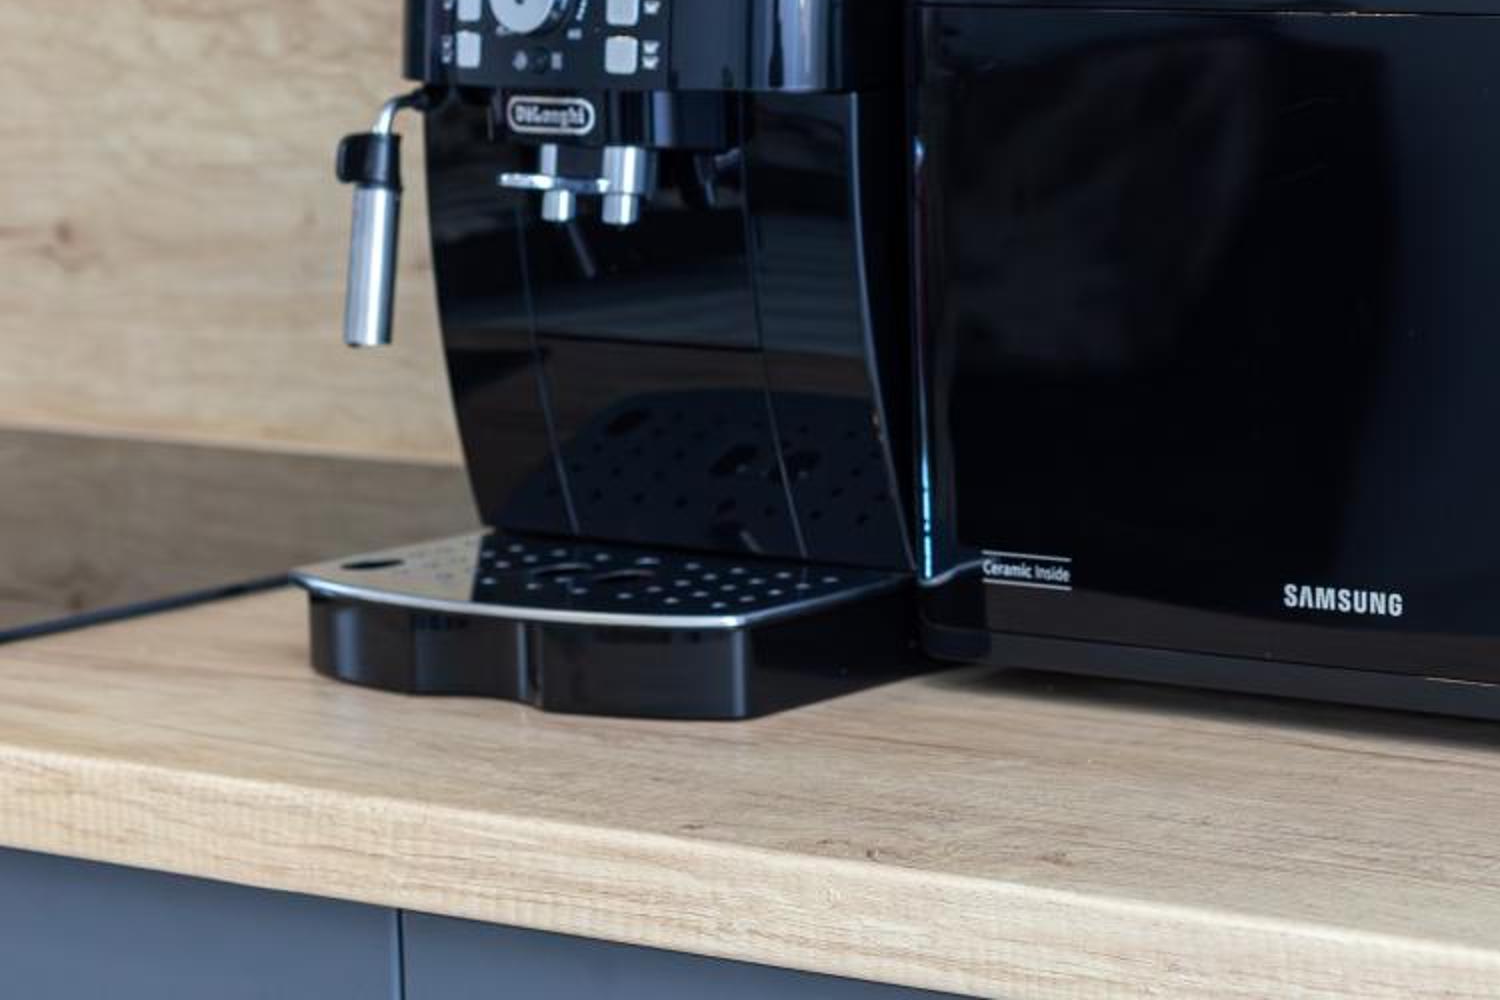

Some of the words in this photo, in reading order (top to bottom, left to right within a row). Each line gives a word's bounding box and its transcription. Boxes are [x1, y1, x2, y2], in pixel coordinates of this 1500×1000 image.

[982, 559, 1032, 579] Ceramic
[1034, 564, 1071, 582] Inside
[1283, 583, 1403, 617] SAMSUNG
